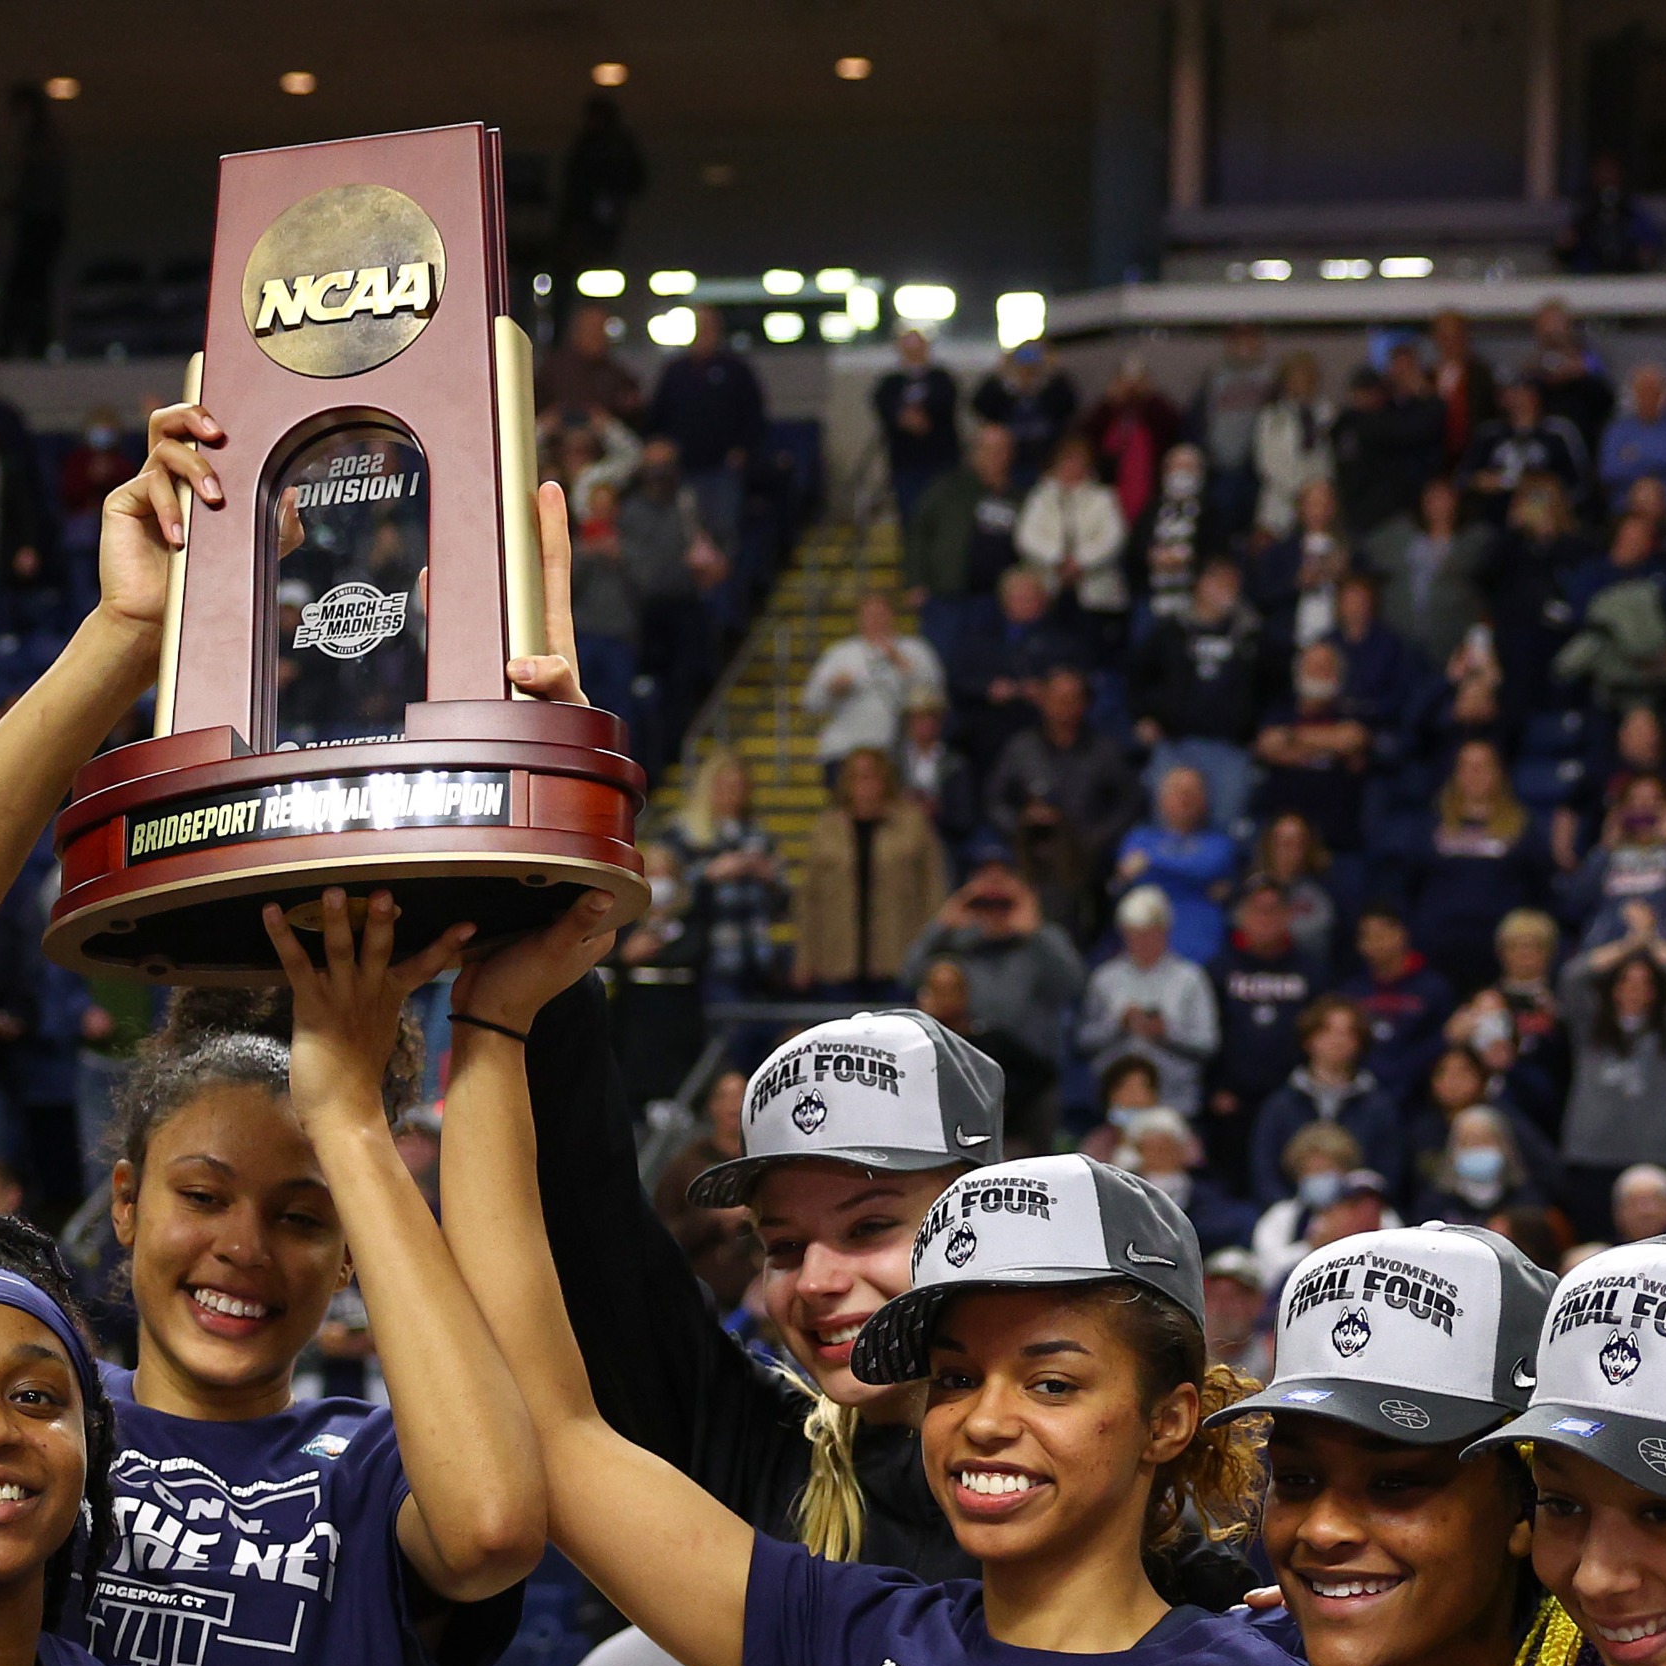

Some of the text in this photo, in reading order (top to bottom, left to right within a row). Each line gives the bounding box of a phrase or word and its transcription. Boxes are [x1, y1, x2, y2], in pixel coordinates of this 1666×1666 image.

[255, 262, 435, 336] NCAA
[329, 453, 384, 477] 2022
[294, 473, 404, 508] DIVISION
[321, 600, 377, 620] MARCH
[326, 614, 404, 636] MADNESS
[132, 798, 261, 857] BRIDGEPORT
[817, 1042, 897, 1064] WOMEN'S
[814, 1054, 900, 1097] FOUR
[964, 1177, 1048, 1192] WOMEN'S
[961, 1188, 1051, 1221] FOUR
[1326, 1254, 1367, 1272] NCAA
[1371, 1255, 1459, 1299] WOMEN'S
[1592, 1276, 1637, 1290] NCAA
[1285, 1268, 1456, 1338] FINAL FOUR
[1549, 1289, 1622, 1346] FINAL
[181, 1594, 206, 1609] CT
